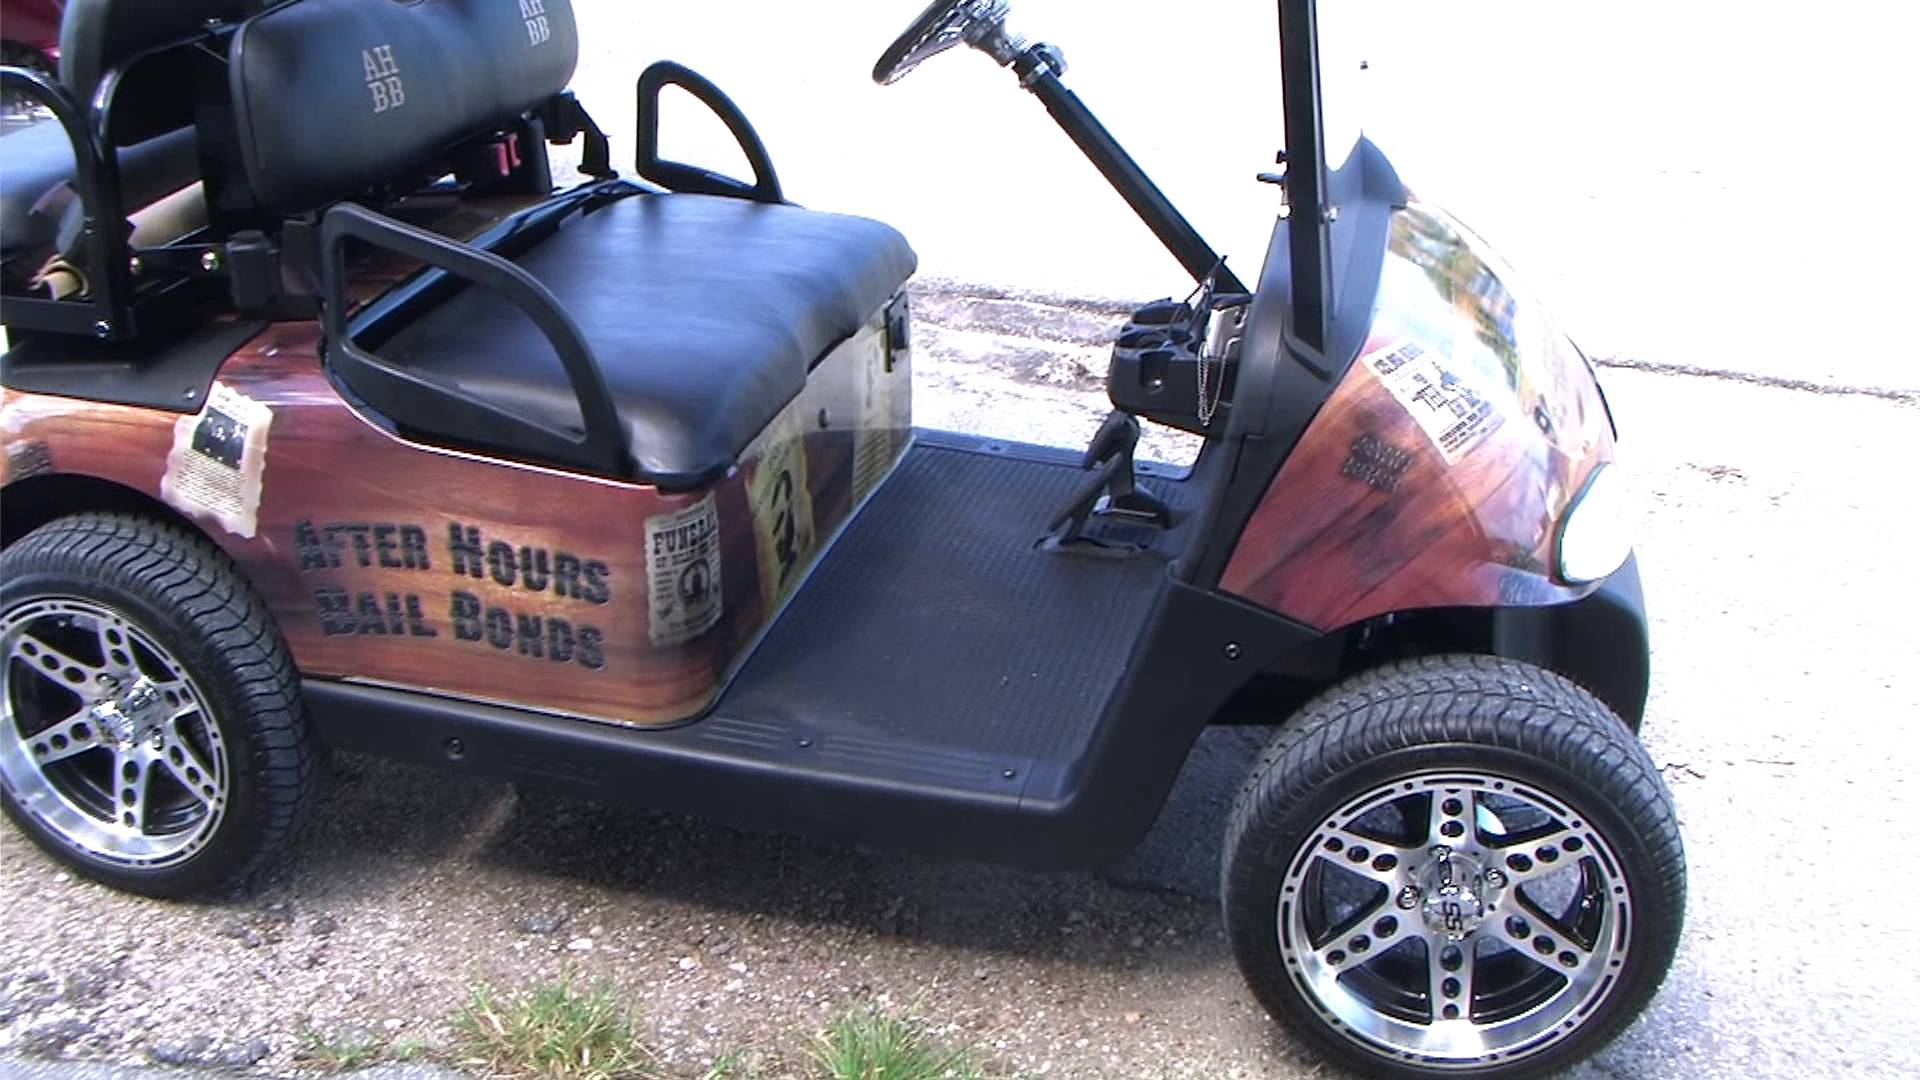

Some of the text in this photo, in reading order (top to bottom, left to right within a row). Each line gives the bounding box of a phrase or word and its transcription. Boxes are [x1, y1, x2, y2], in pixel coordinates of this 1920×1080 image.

[518, 0, 545, 19] AH
[525, 16, 550, 46] BB
[362, 45, 399, 81] AH
[368, 77, 405, 112] BB
[296, 520, 431, 570] AFTER
[449, 521, 609, 604] HOURS
[315, 584, 438, 637] BAIL
[451, 590, 605, 670] BONDS
